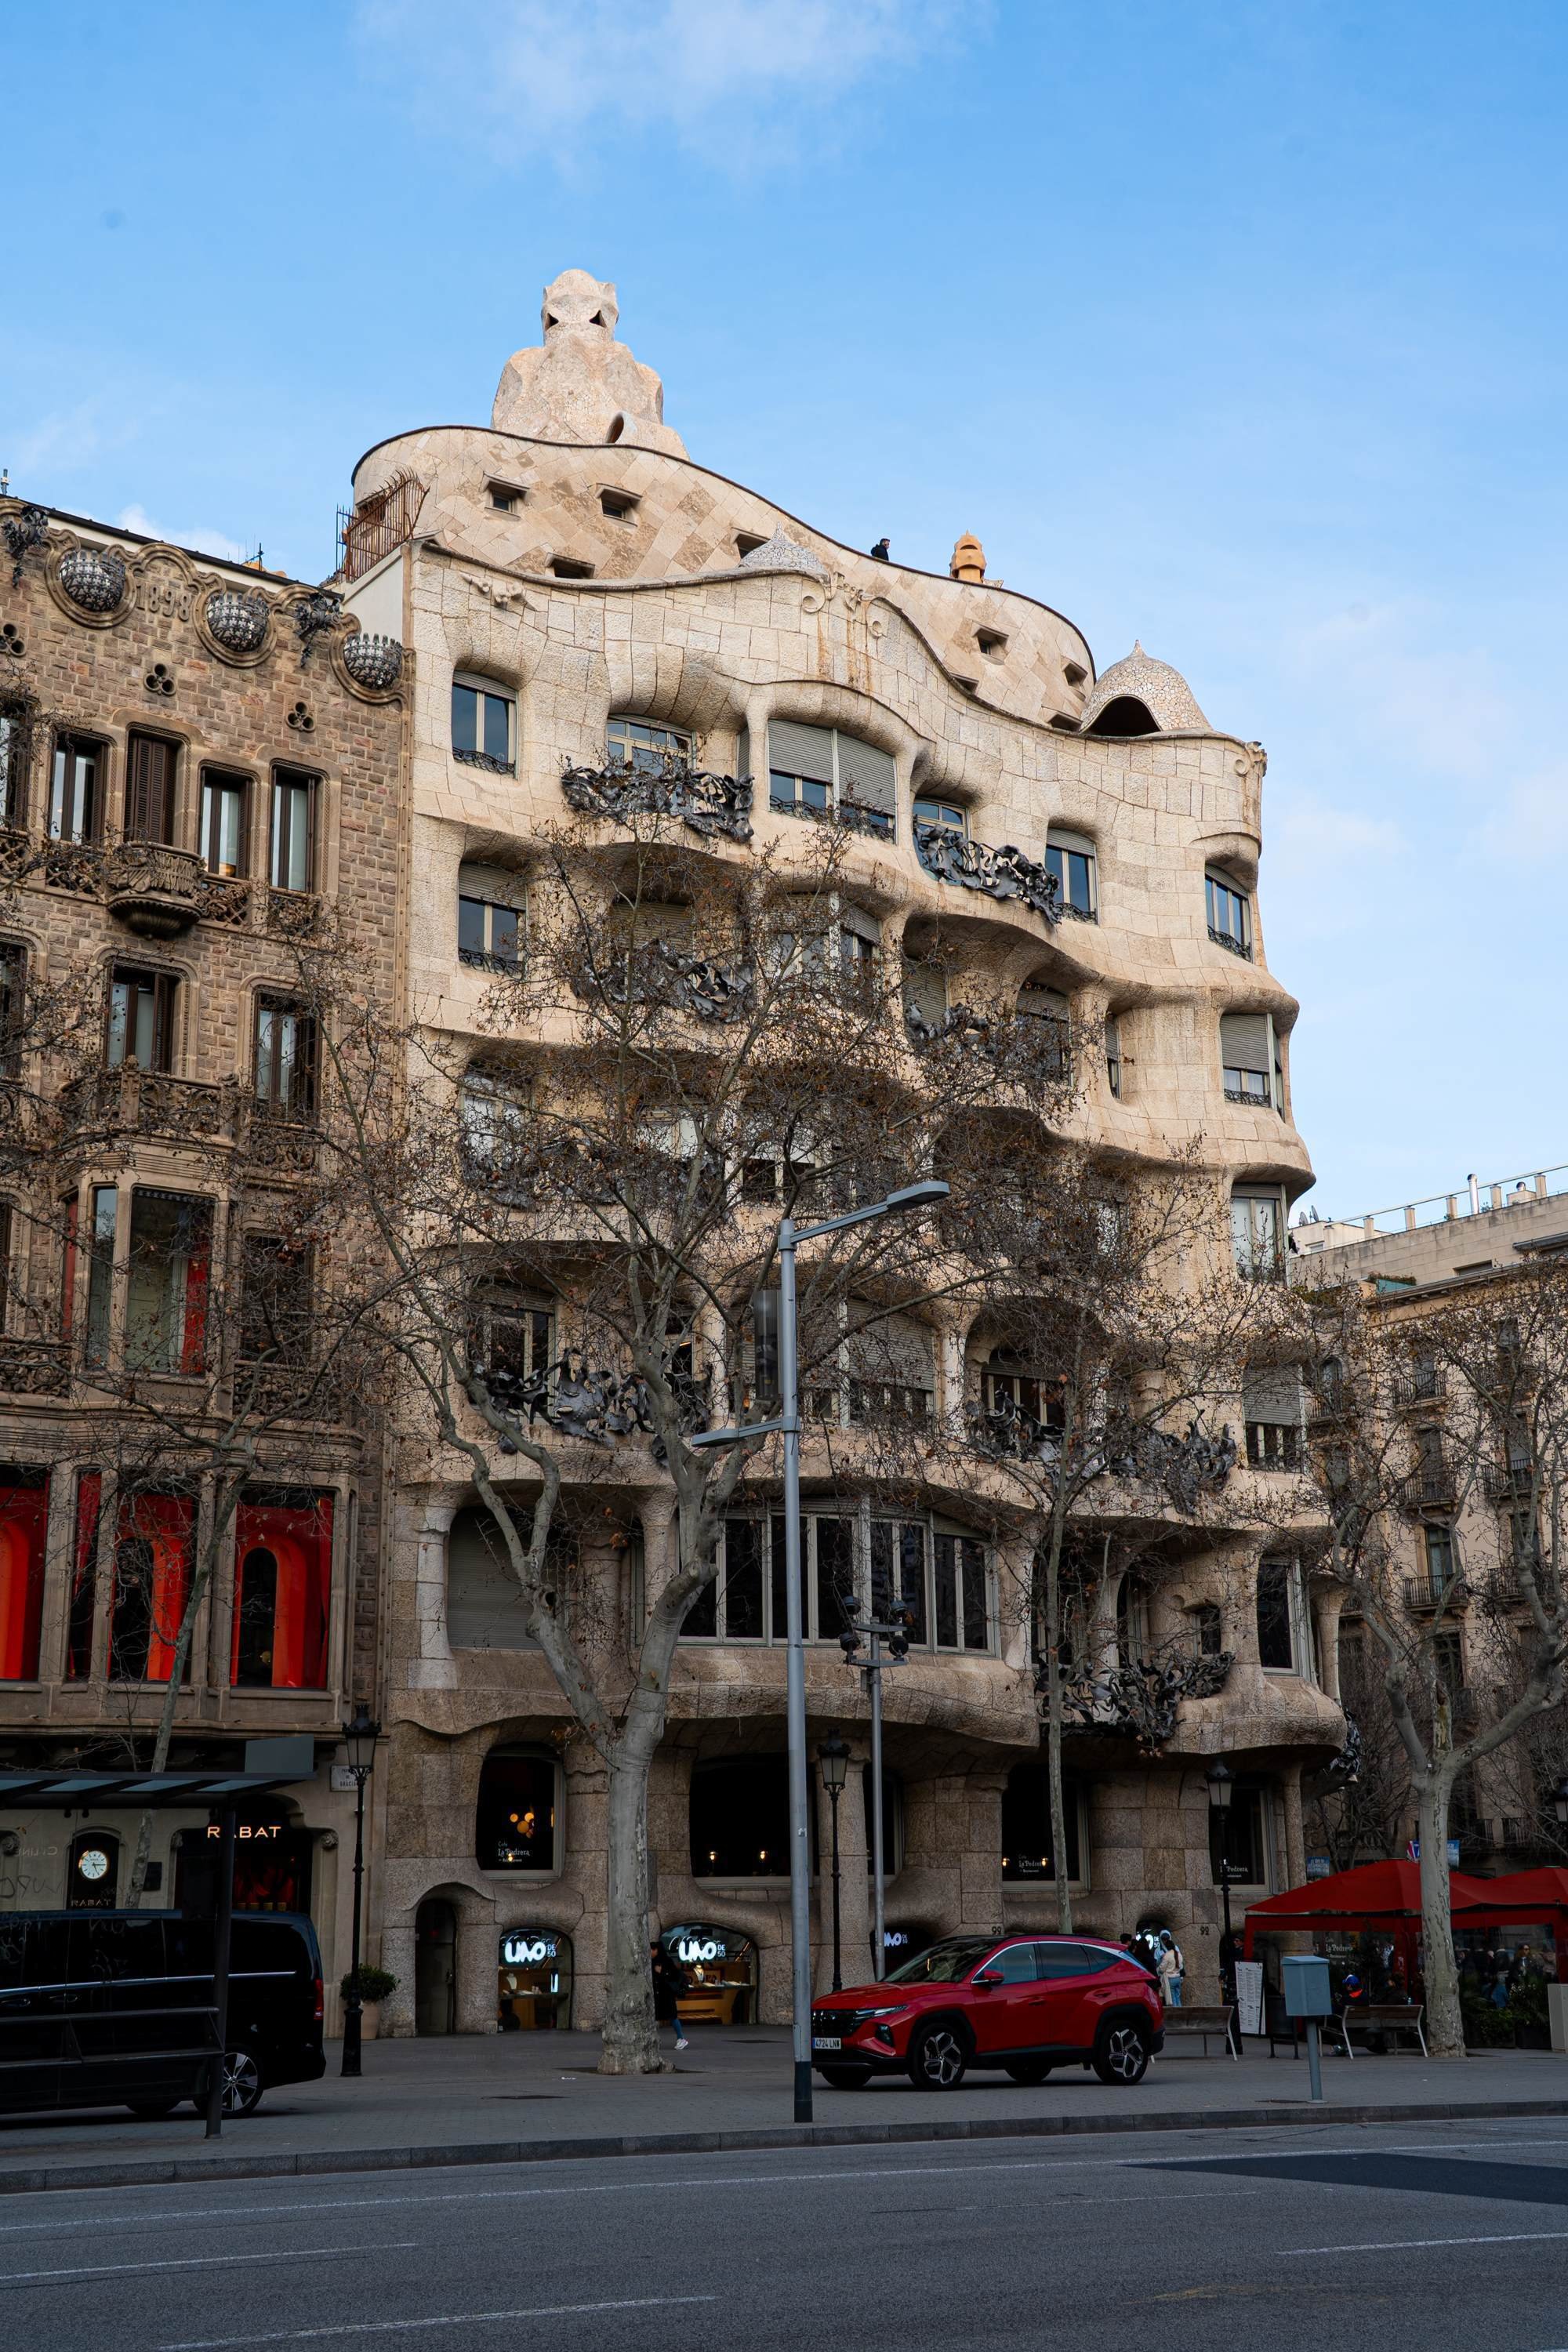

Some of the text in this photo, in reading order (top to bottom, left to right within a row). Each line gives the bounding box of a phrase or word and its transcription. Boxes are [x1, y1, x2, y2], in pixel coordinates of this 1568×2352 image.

[136, 583, 191, 621] 1898
[207, 1826, 282, 1838] RBAT
[884, 1932, 902, 1947] NO
